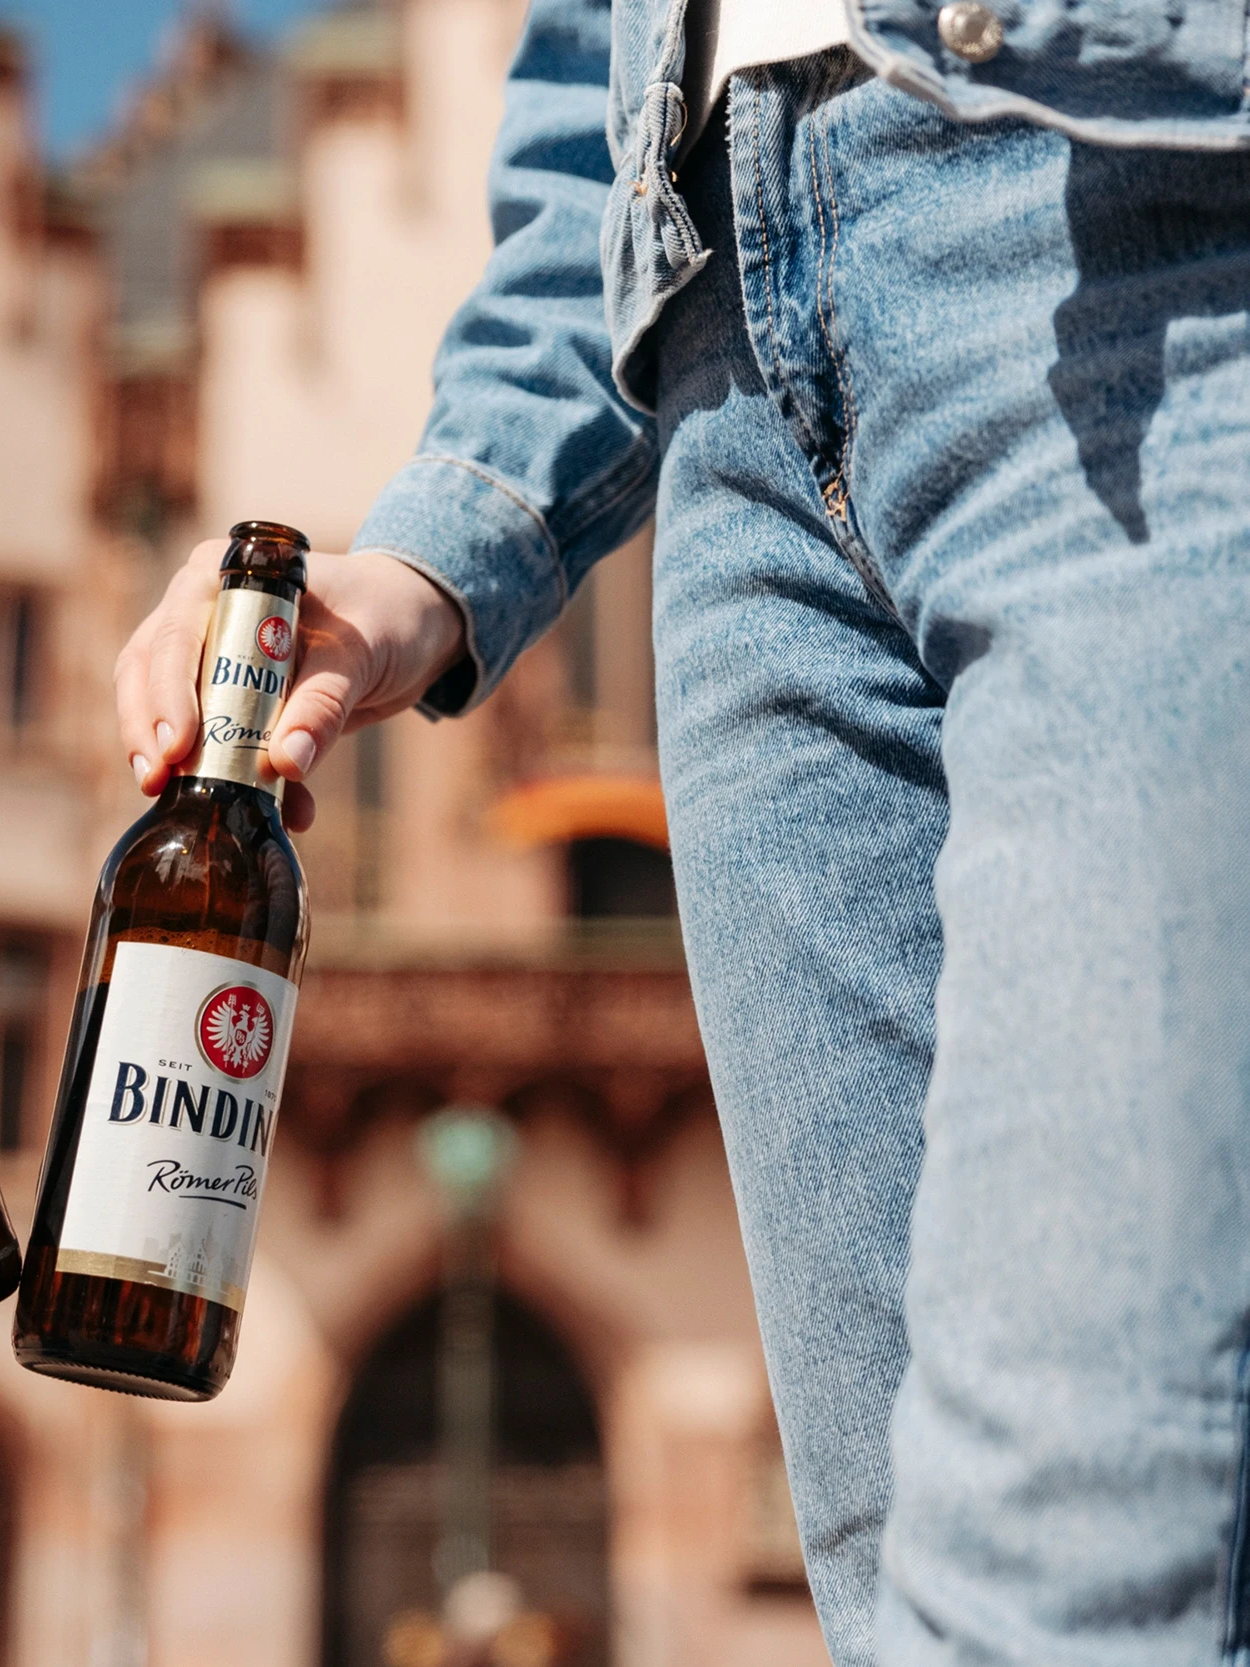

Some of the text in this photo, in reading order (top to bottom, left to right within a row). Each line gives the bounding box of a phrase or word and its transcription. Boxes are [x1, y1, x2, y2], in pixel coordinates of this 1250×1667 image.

[202, 715, 271, 748] Röme
[158, 1058, 193, 1073] SEIT
[108, 1060, 274, 1158] BINDIN
[147, 1159, 235, 1193] Römer
